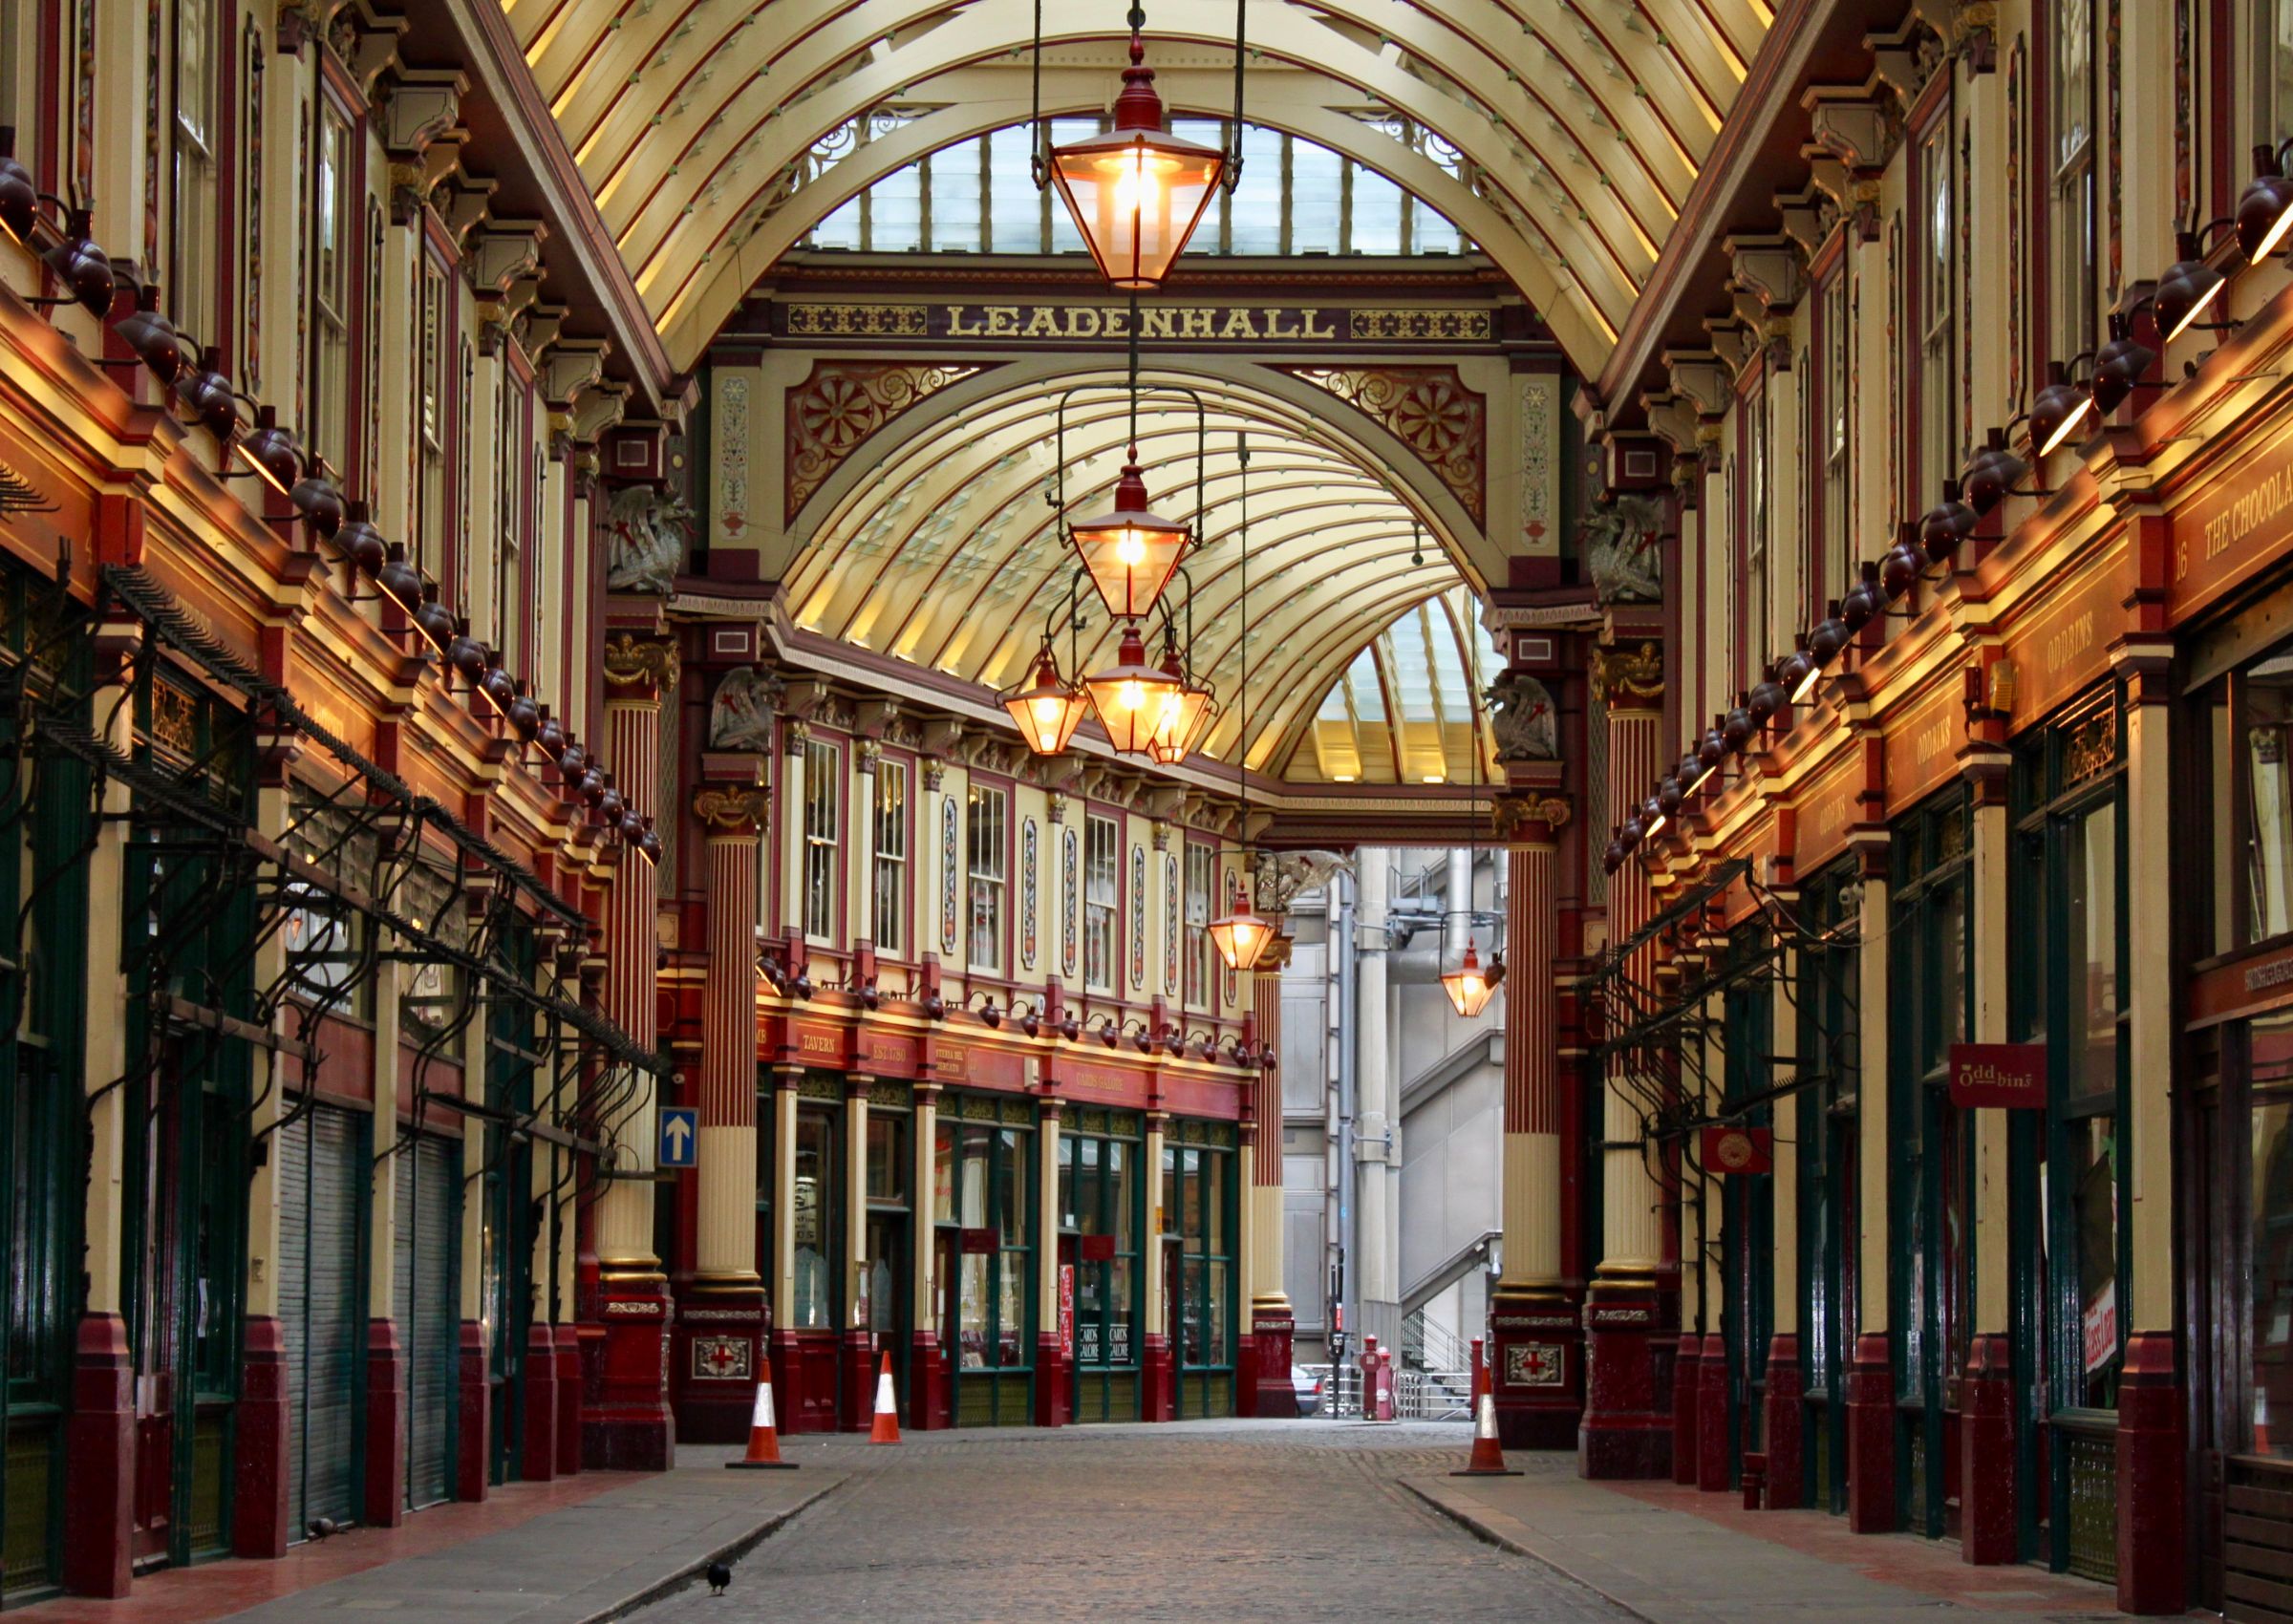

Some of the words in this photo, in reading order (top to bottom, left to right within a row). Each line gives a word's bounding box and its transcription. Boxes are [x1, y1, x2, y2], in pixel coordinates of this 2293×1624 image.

[947, 306, 1335, 338] LEADENHALL
[2176, 541, 2188, 582] 16
[2205, 510, 2229, 561] THE
[2233, 460, 2293, 542] CHOCOLA
[2047, 609, 2092, 673] ODDBINS
[1917, 715, 1951, 764] ODDBINS
[803, 1035, 835, 1053] TAVERN
[1109, 1328, 1128, 1342] CARDS
